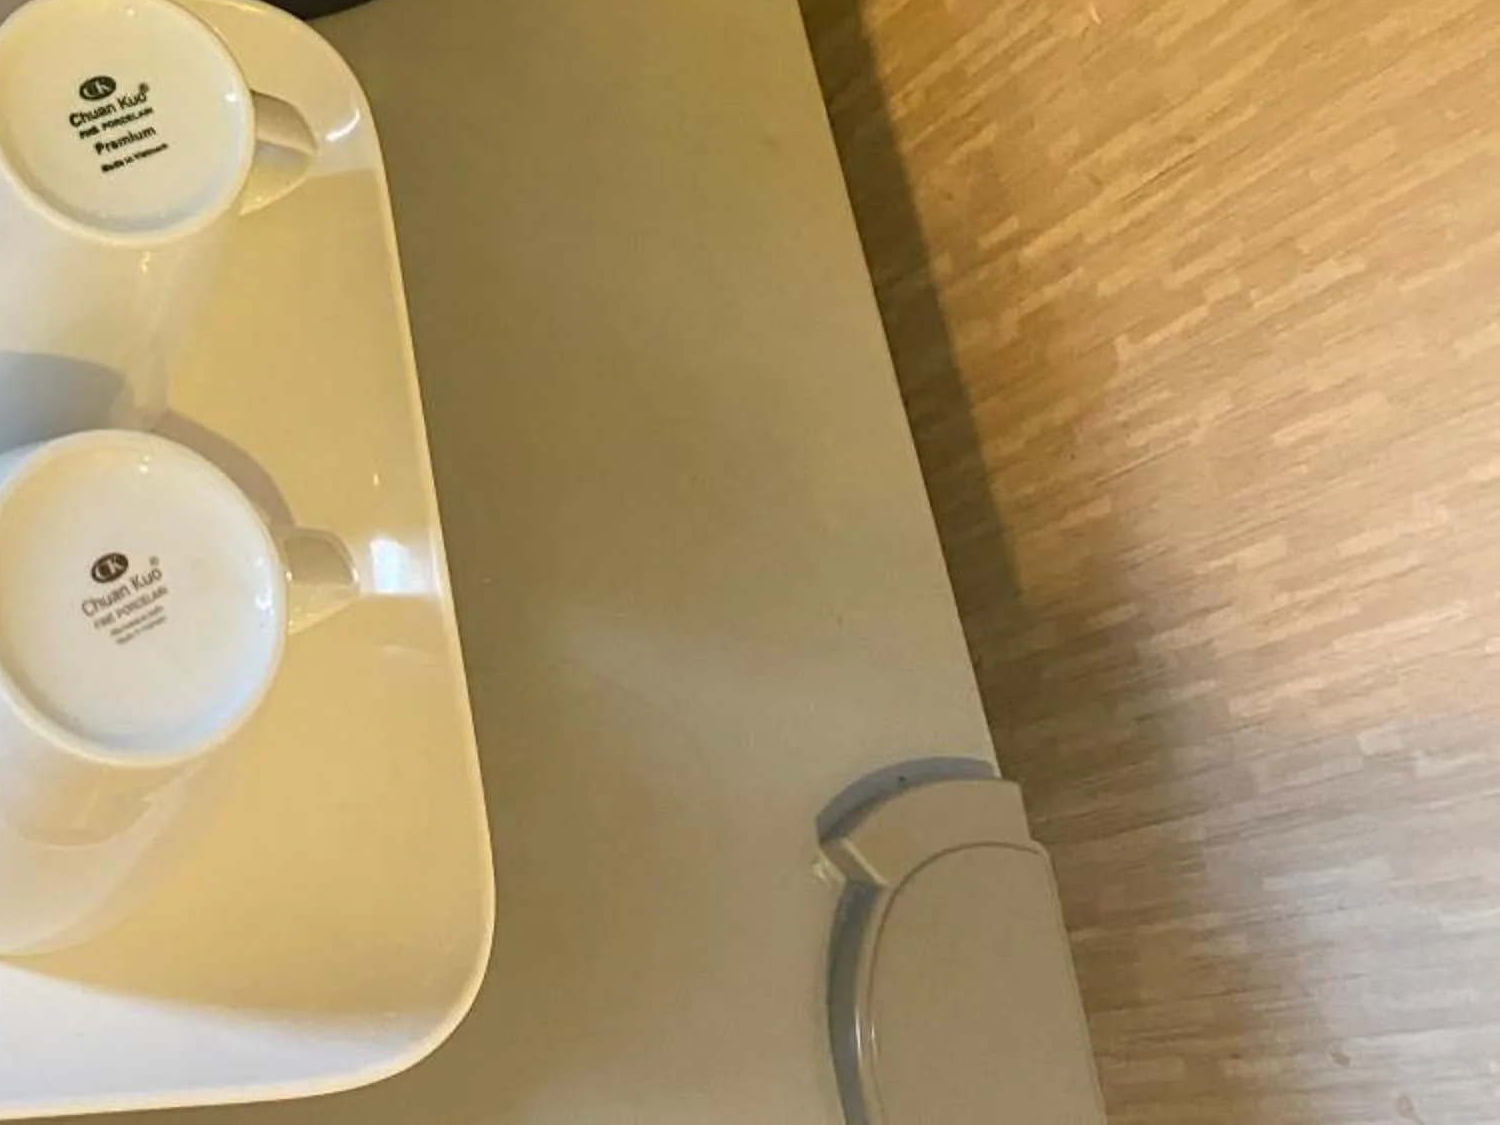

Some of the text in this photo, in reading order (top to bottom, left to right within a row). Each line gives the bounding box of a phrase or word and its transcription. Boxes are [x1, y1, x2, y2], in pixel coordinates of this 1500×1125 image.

[68, 104, 117, 128] Chuan
[94, 126, 157, 155] Premium
[82, 568, 162, 617] Chuan Kuo
